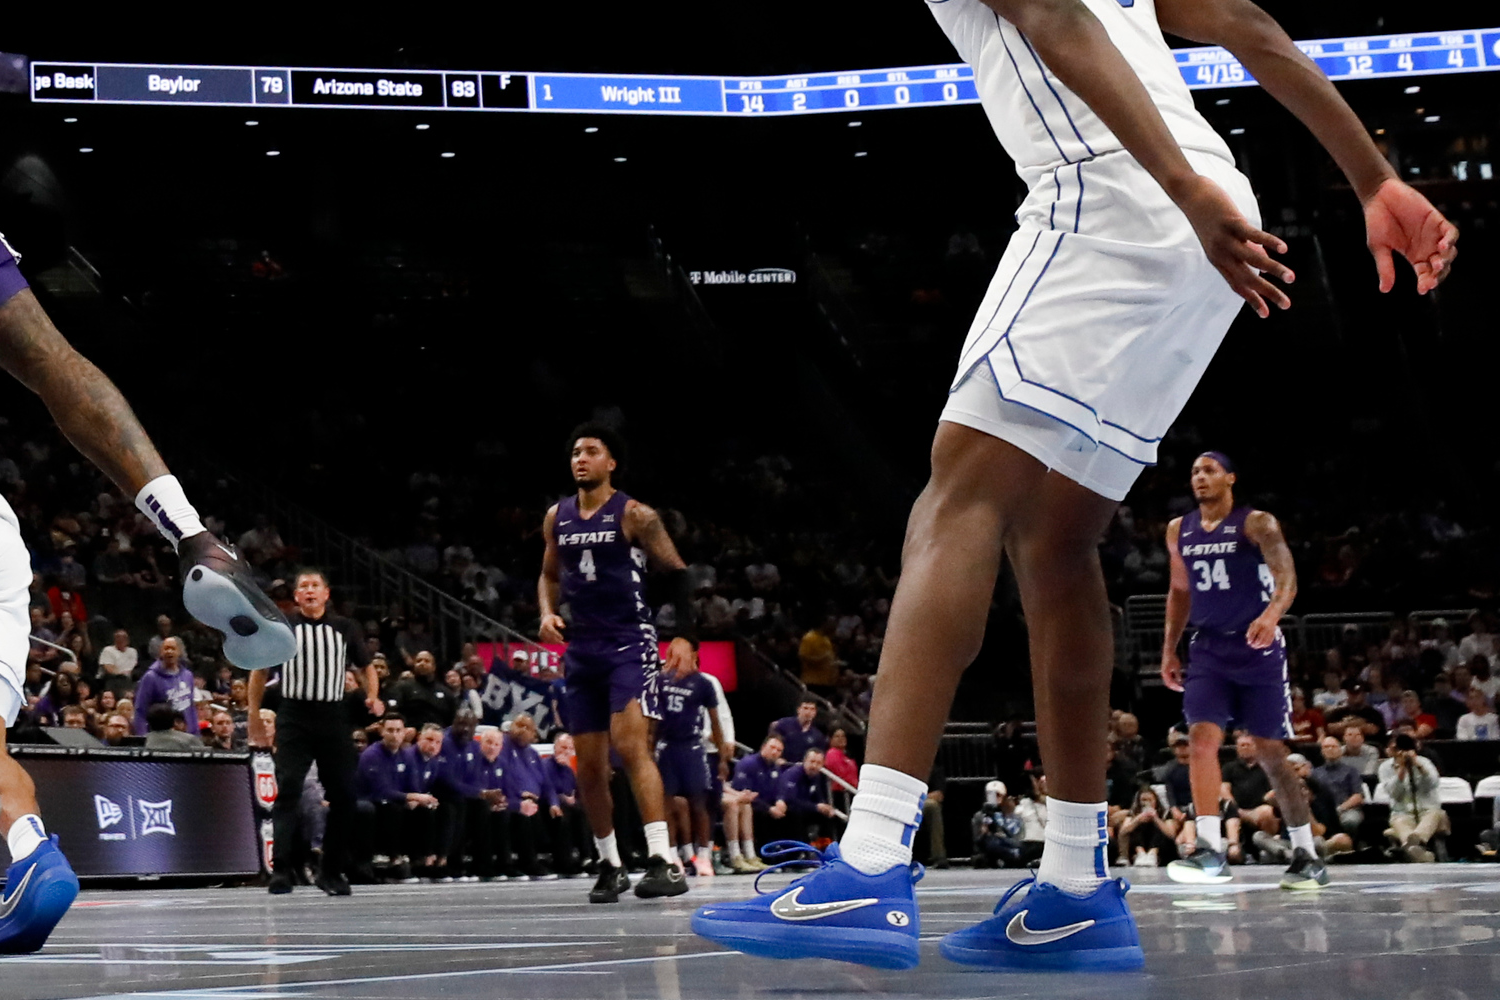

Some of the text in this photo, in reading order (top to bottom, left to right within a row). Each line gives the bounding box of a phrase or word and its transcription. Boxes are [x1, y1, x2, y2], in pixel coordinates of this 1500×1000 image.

[1197, 50, 1463, 83] 4/15 12 4 4
[54, 73, 94, 89] Bask
[148, 75, 201, 94] Baylor
[261, 77, 283, 93] 79
[313, 78, 423, 97] Arizona State
[452, 81, 475, 98] 83
[500, 74, 510, 90] F
[543, 84, 681, 106] 1 Wright III
[742, 83, 958, 112] 14 2 0 0 0
[703, 270, 746, 284] Mobile
[748, 272, 791, 284] CENTER
[558, 531, 616, 546] K-STATE
[1182, 541, 1238, 556] K-STATE
[579, 549, 597, 581] 4
[1193, 559, 1231, 592] 34
[667, 695, 685, 712] 15
